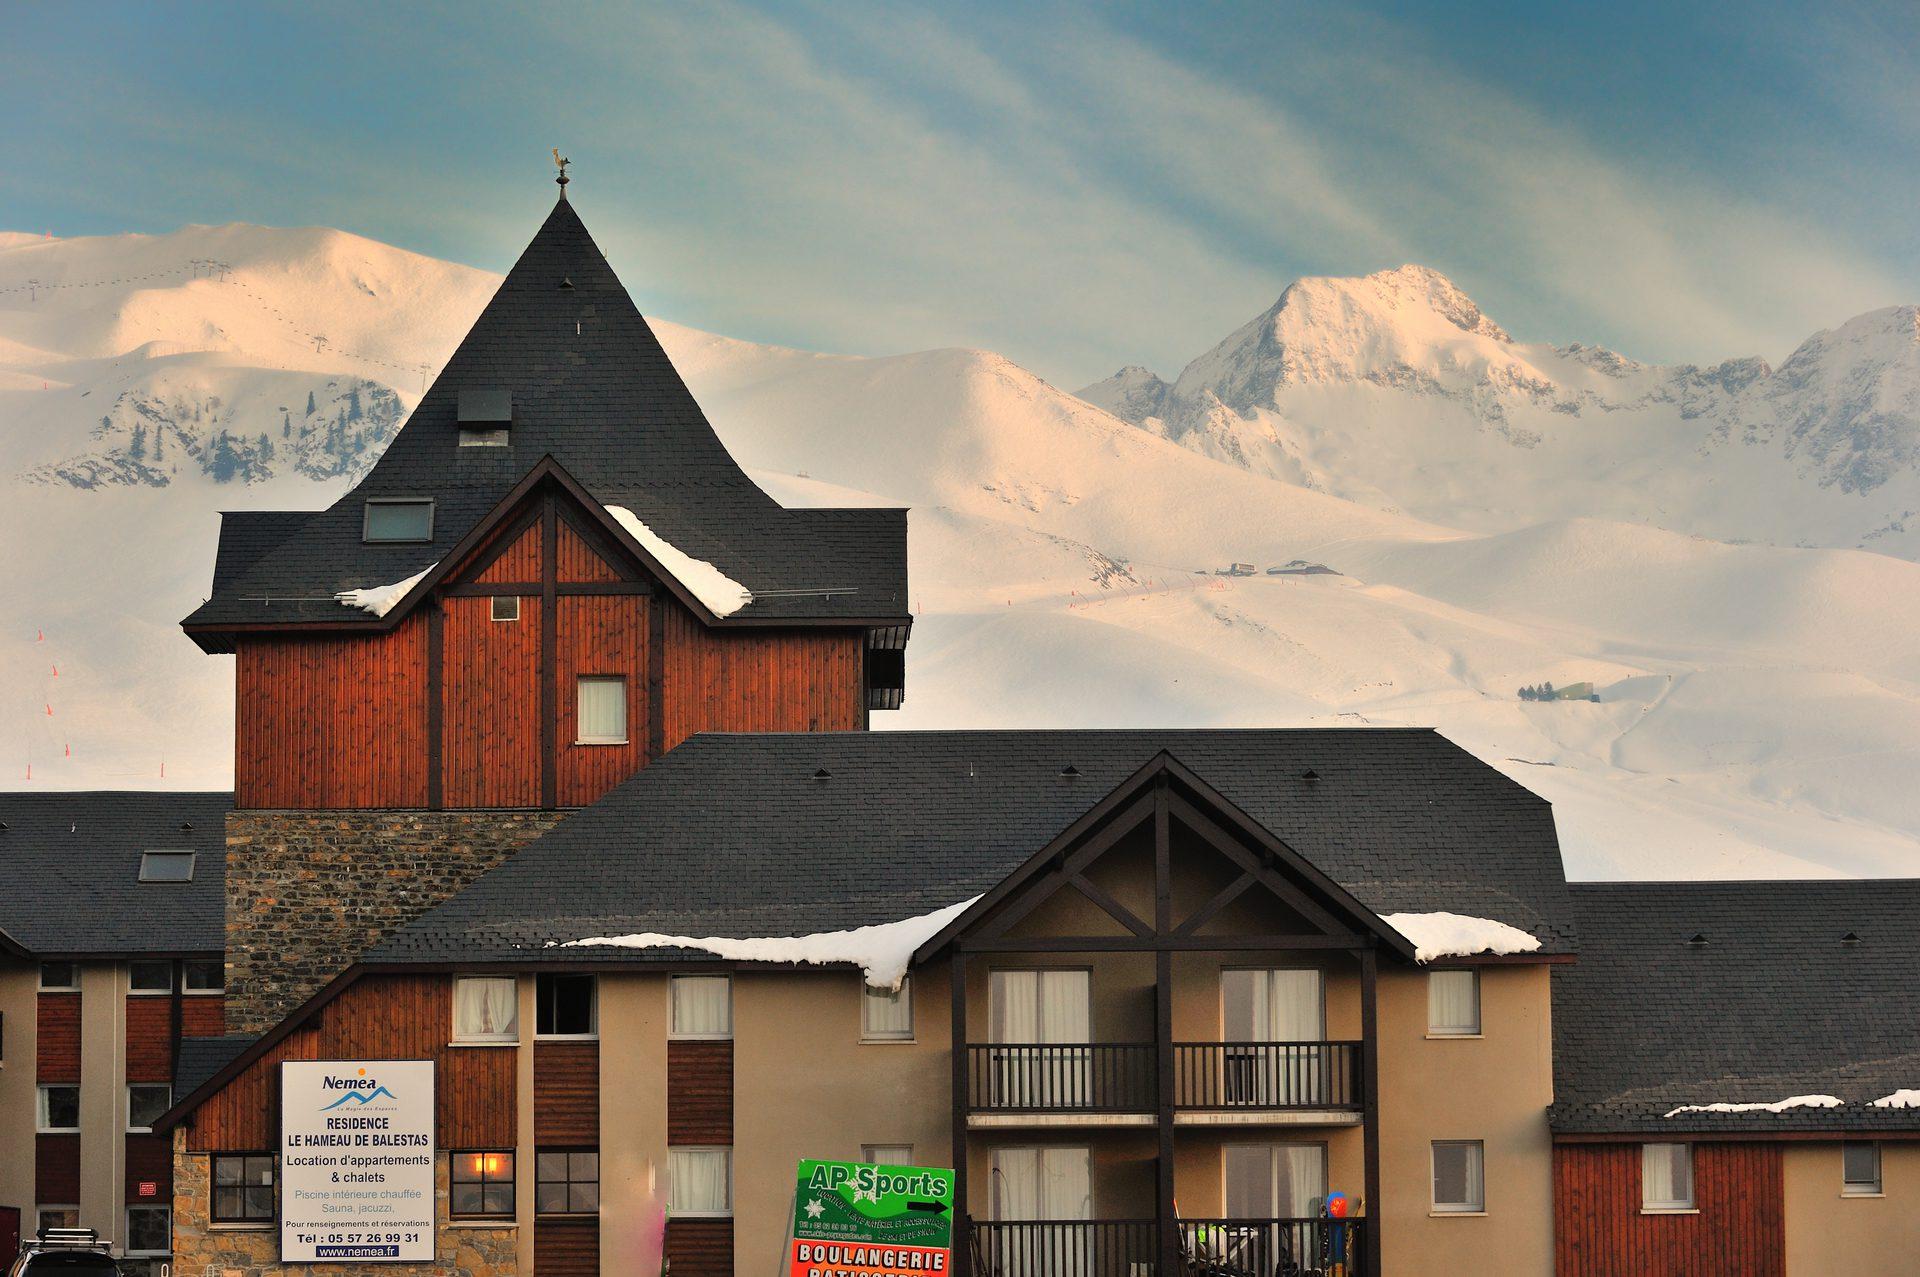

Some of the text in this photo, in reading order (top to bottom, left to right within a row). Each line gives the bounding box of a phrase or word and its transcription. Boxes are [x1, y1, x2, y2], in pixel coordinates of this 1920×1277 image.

[327, 1117, 389, 1130] RESIDENCE
[288, 1134, 429, 1147] LE HAMEAU DE BALESTAS
[286, 1154, 430, 1168] Location d'appartements
[331, 1172, 386, 1183] & chalets
[809, 1165, 948, 1200] AP Sports
[295, 1189, 422, 1200] Piscine intérieure chauffée
[322, 1203, 396, 1215] Sauna, jacuzzi,
[306, 1221, 370, 1230] renseignements
[381, 1220, 430, 1228] réservations
[297, 1233, 317, 1243] Tél
[328, 1234, 343, 1243] 05
[347, 1234, 362, 1243] 57
[366, 1233, 382, 1243] 26
[385, 1233, 401, 1243] 99
[405, 1233, 420, 1243] 31
[319, 1246, 396, 1257] www.nemea.fr
[798, 1244, 945, 1271] BOULANGERIE
